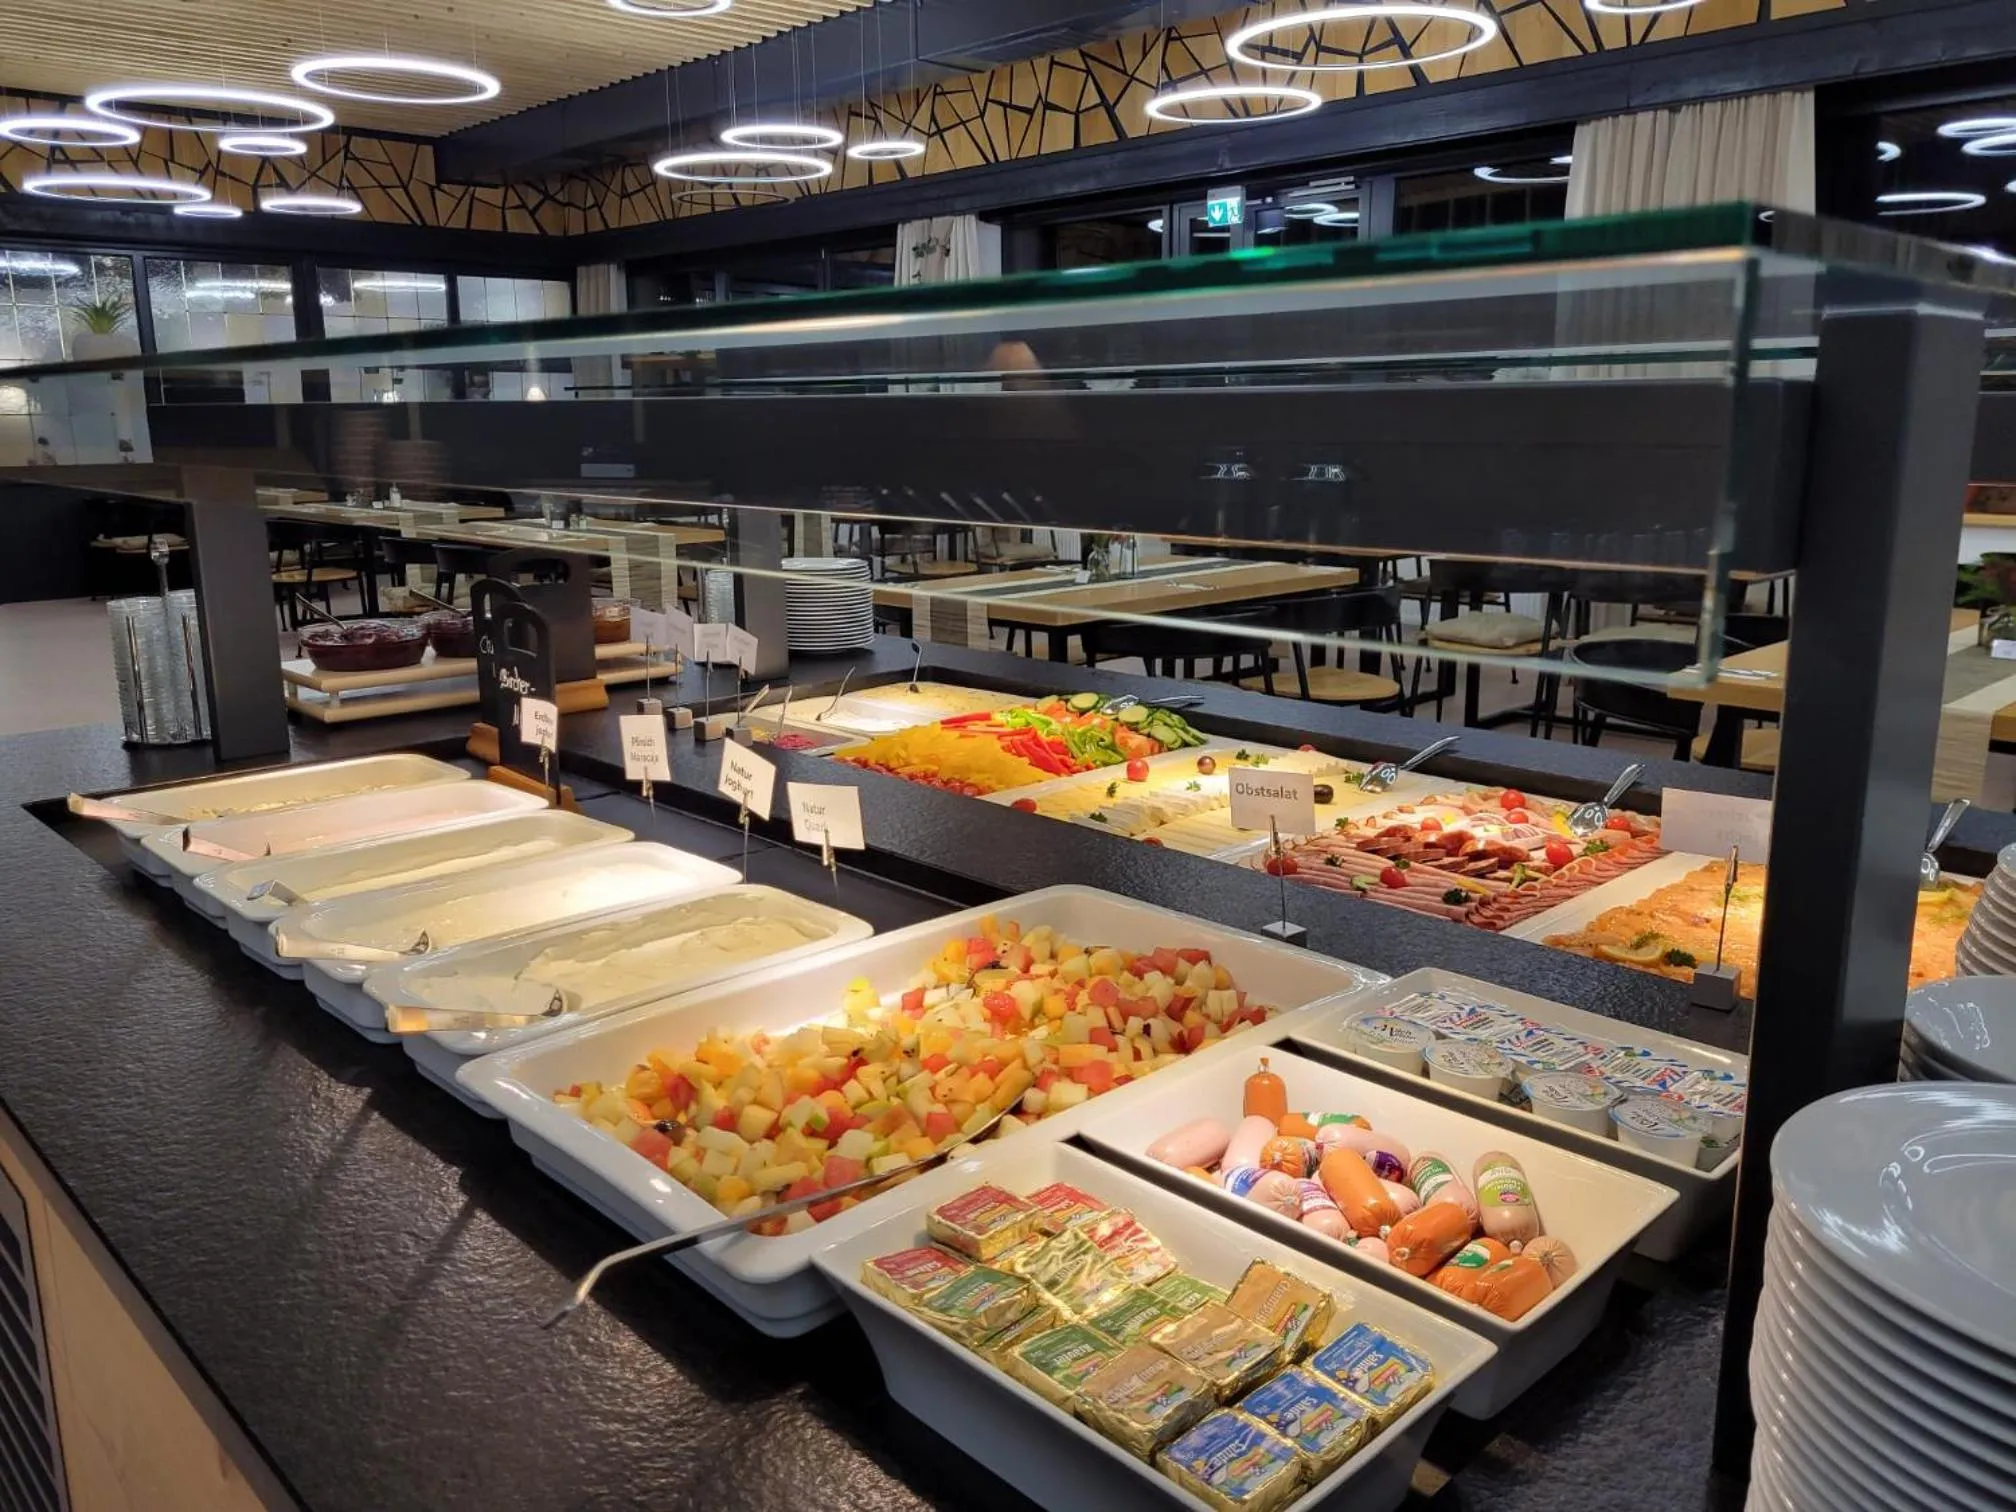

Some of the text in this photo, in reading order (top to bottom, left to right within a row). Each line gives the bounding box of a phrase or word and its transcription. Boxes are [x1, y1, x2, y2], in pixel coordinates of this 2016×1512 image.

[730, 759, 753, 780] Natur
[1235, 782, 1298, 801] Obstsalat
[802, 801, 826, 816] Natur
[1352, 1350, 1384, 1377] Sahne
[1284, 1396, 1318, 1420] Sahne
[1214, 1440, 1245, 1467] Sahne
